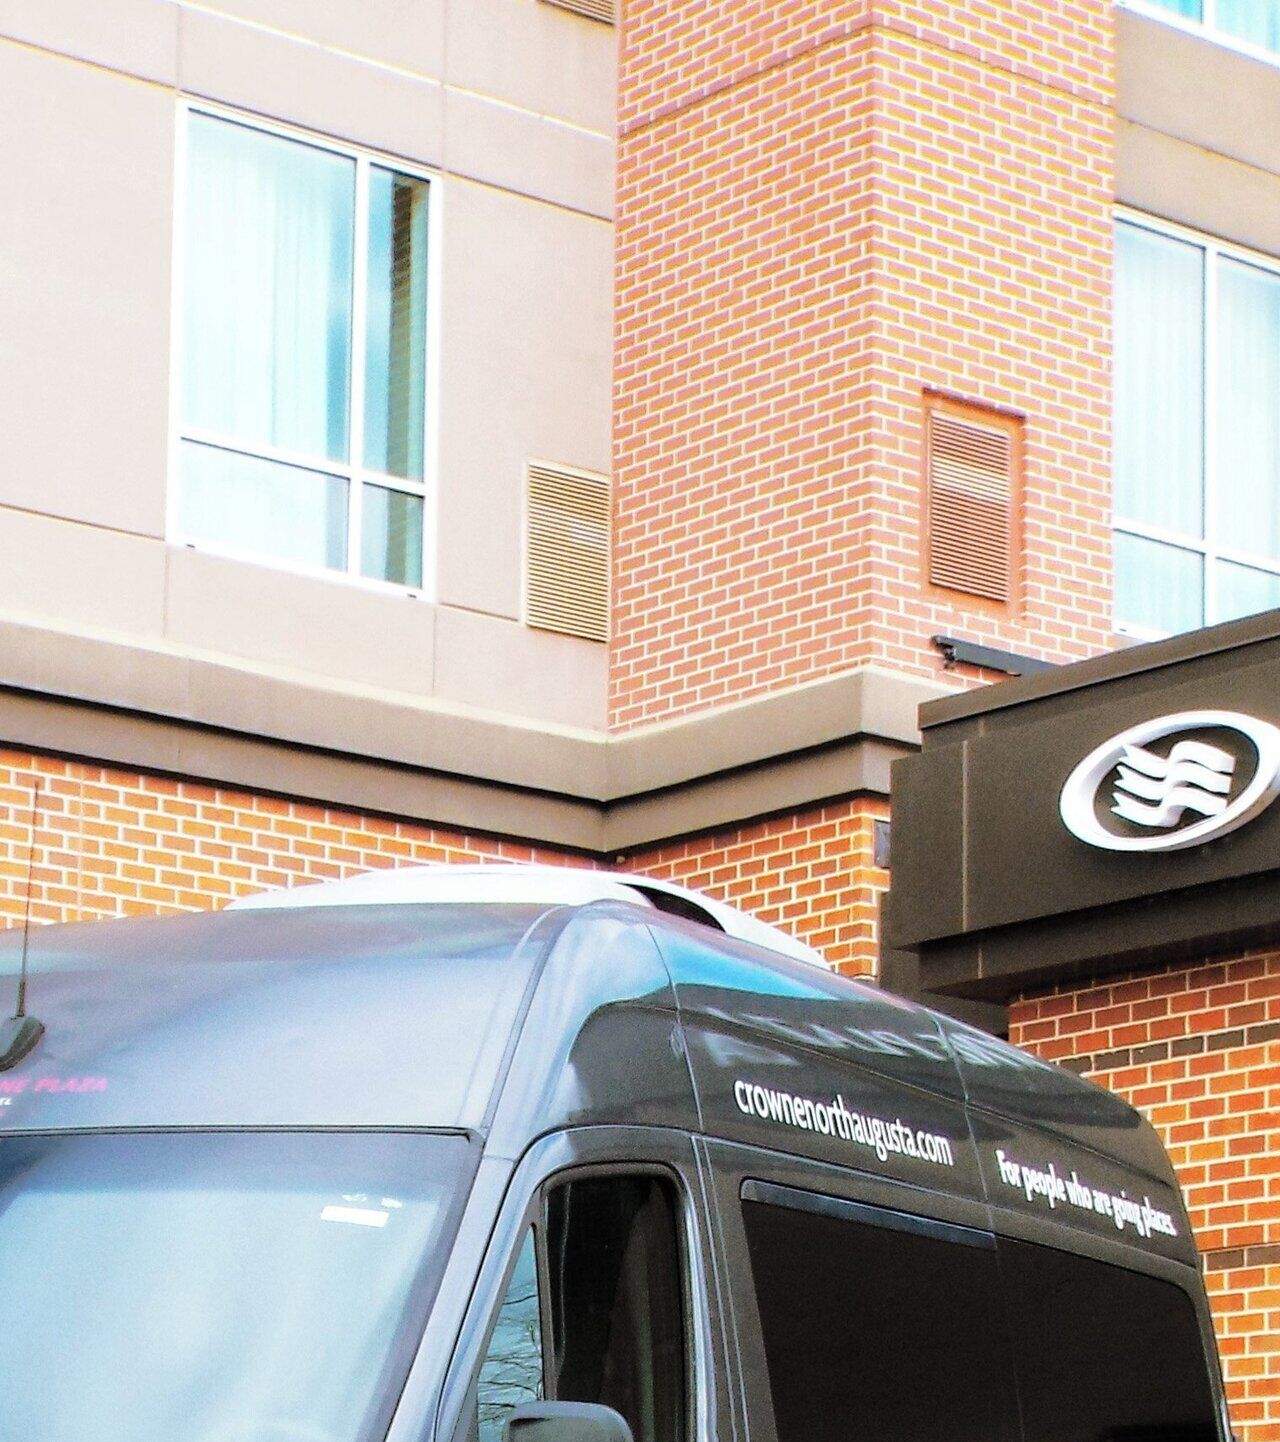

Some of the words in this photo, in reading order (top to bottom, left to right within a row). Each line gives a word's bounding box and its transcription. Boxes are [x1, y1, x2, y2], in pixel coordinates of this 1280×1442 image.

[734, 1078, 955, 1167] crownenorthaugusta.com
[995, 1149, 1022, 1188] For
[1021, 1162, 1067, 1210] people
[1065, 1170, 1094, 1210] who
[1092, 1189, 1113, 1217] are
[1111, 1189, 1146, 1237] going
